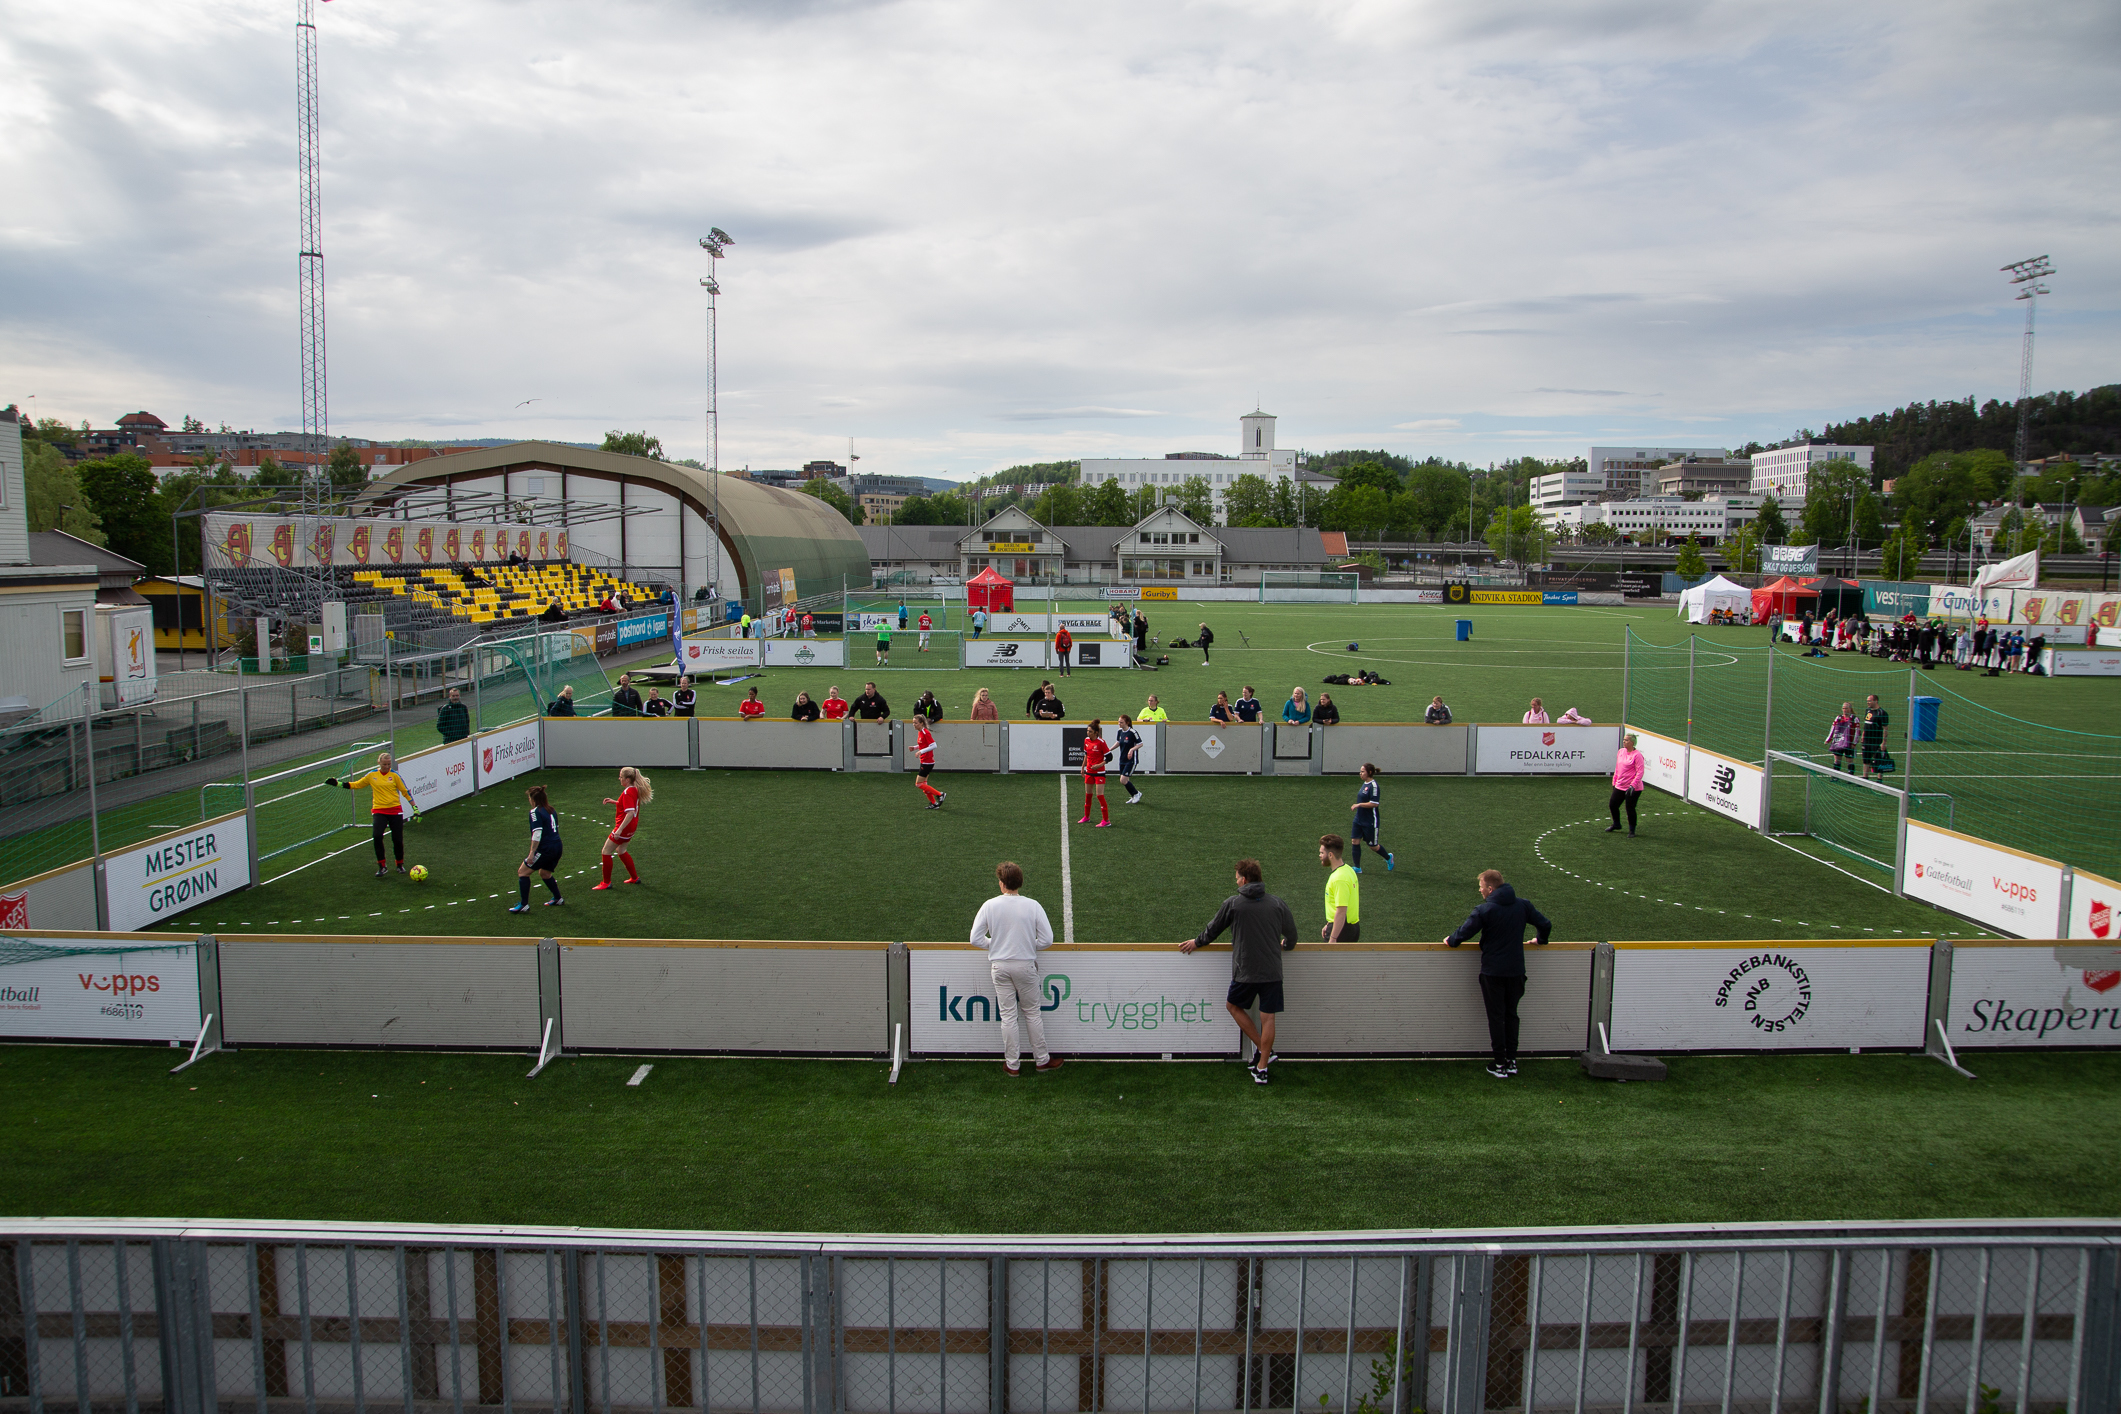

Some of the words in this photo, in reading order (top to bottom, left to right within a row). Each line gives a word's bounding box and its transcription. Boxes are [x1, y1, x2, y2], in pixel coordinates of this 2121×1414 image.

[1470, 593, 1506, 602] ANDVIKA
[1509, 593, 1541, 602] STADION
[620, 620, 646, 642] postnord
[1007, 617, 1031, 632] OSLOMET
[702, 645, 725, 655] Frisk
[728, 646, 754, 655] seilas
[495, 742, 513, 761] Frisk
[515, 736, 535, 755] seilas
[1510, 750, 1585, 760] PEDALKRAFT
[1705, 792, 1717, 803] new
[1716, 795, 1738, 812] balance
[550, 813, 557, 833] 4
[145, 833, 217, 877] MESTER
[1926, 865, 1973, 891] Gatefotball
[149, 867, 218, 912] GRØNN
[1715, 953, 1811, 1033] SPAREBANKSTIFTELSEN
[1744, 978, 1771, 1011] DNB
[100, 1006, 143, 1020] #686119
[1076, 995, 1213, 1030] trygghet
